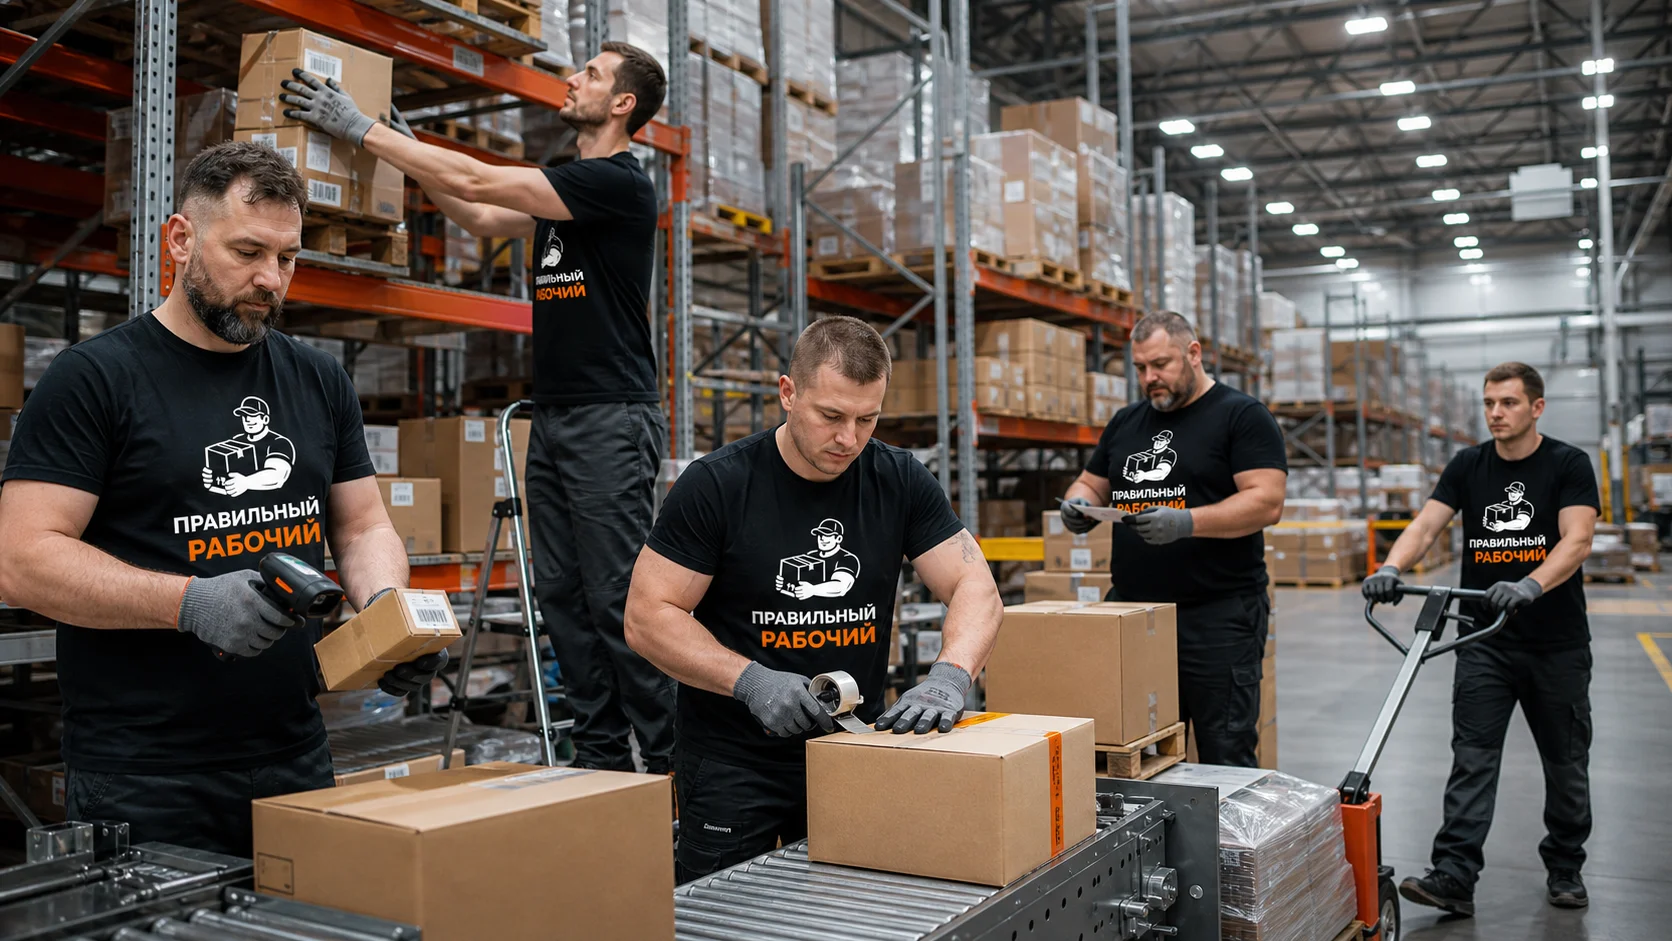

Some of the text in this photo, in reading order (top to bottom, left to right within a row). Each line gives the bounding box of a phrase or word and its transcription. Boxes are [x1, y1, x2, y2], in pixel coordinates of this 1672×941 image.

[535, 269, 584, 286] ЛЬНЫЙ
[536, 282, 586, 301] БОЧИЙ
[1112, 484, 1186, 501] ПРАВИЛЬНЫЙ
[173, 496, 320, 534] ПРАВИЛЬНЫЙ
[188, 518, 321, 562] РАБОЧИЙ
[1469, 534, 1546, 549] ПРАВИЛЬНЫЙ
[1475, 546, 1547, 563] РАБОЧИЙ
[752, 603, 876, 625] ПРАВИЛЬНЫЙ
[761, 622, 876, 648] РАБОЧИЙ
